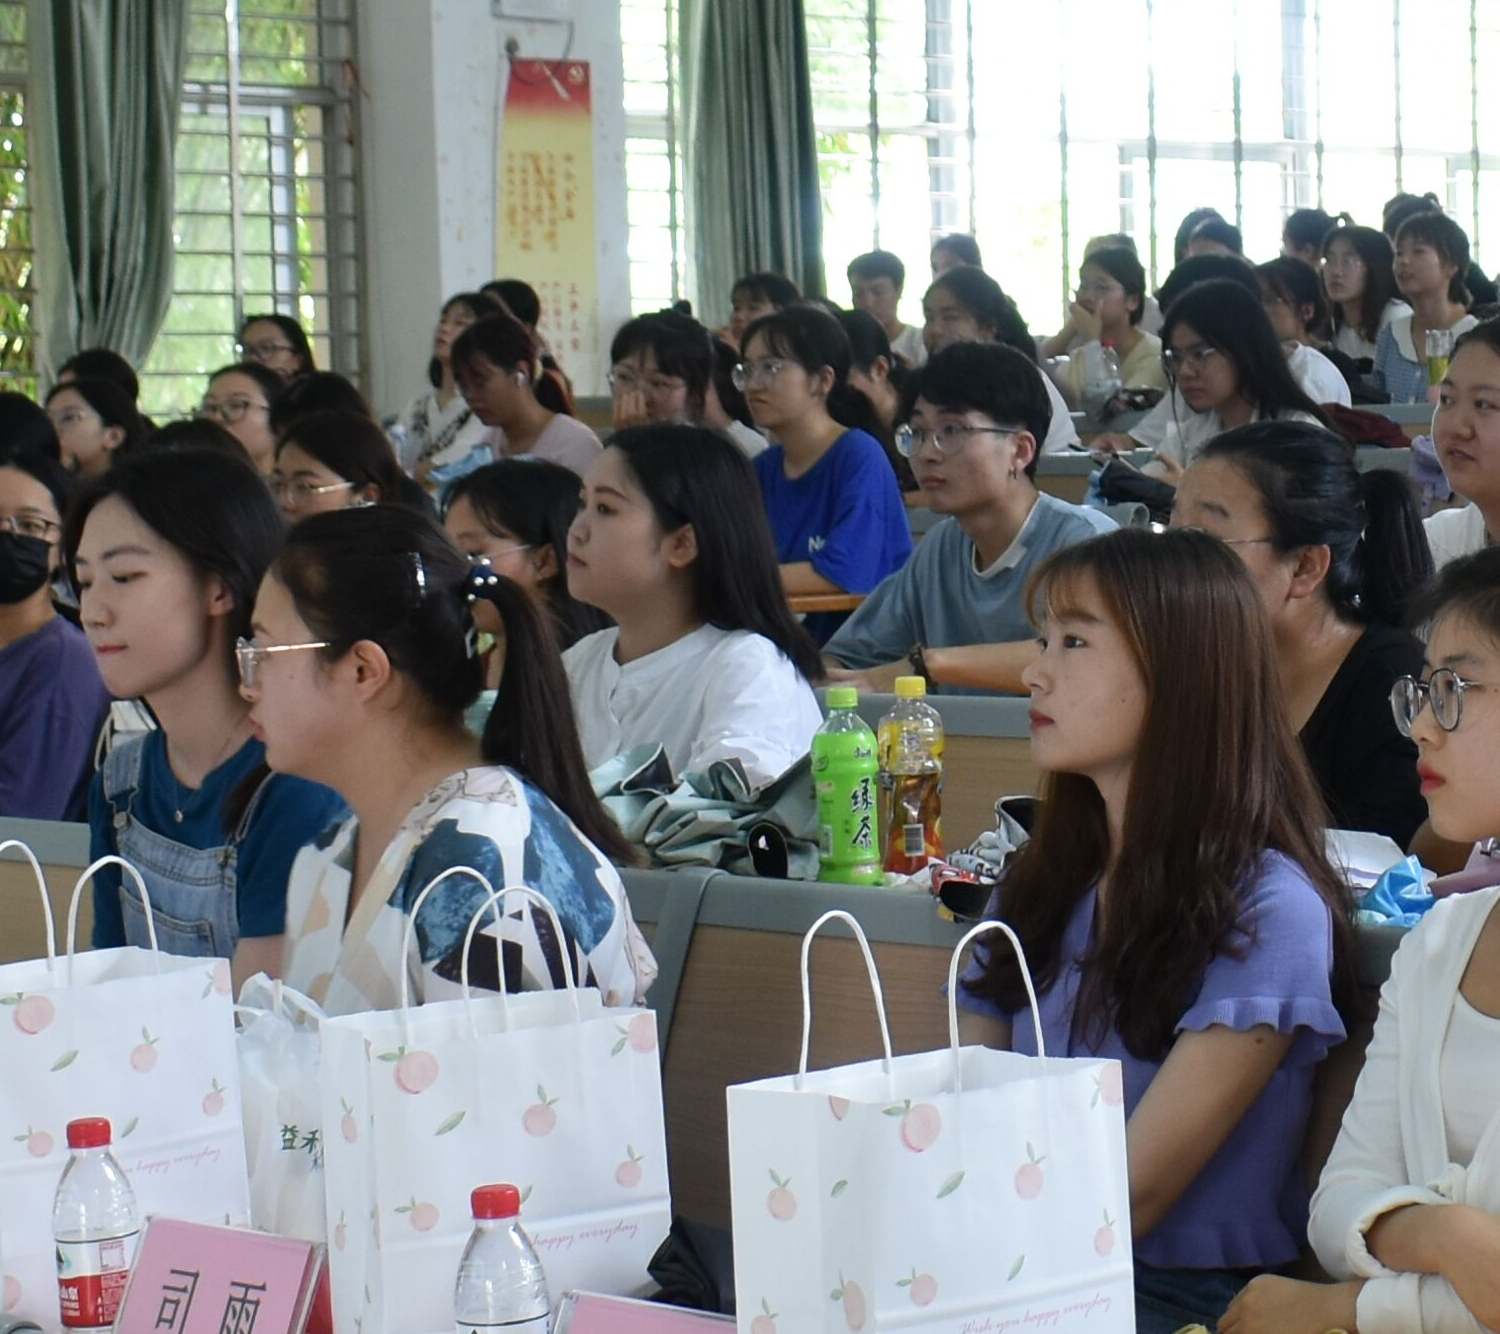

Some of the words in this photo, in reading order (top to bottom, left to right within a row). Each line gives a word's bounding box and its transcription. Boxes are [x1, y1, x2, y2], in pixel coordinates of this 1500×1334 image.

[850, 776, 873, 849] 绿茶
[533, 1233, 575, 1250] happy
[579, 1218, 639, 1244] everyday
[1022, 1309, 1060, 1328] happy
[1063, 1291, 1112, 1318] everyday
